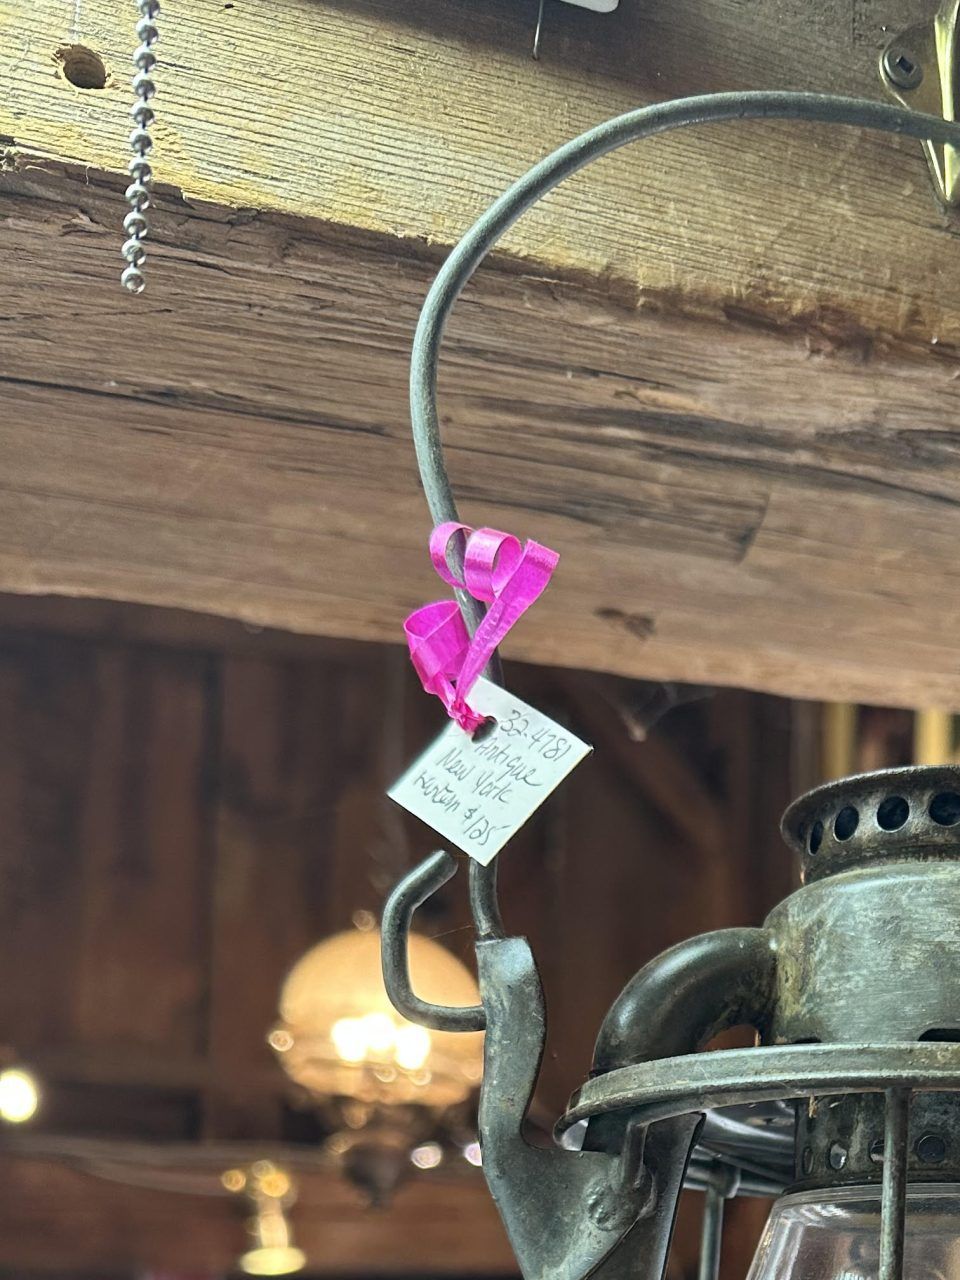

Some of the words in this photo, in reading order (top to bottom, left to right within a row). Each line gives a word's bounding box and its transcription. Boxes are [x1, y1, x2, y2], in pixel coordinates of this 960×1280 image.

[436, 747, 474, 781] New
[474, 767, 515, 804] York
[473, 737, 543, 787] Antique
